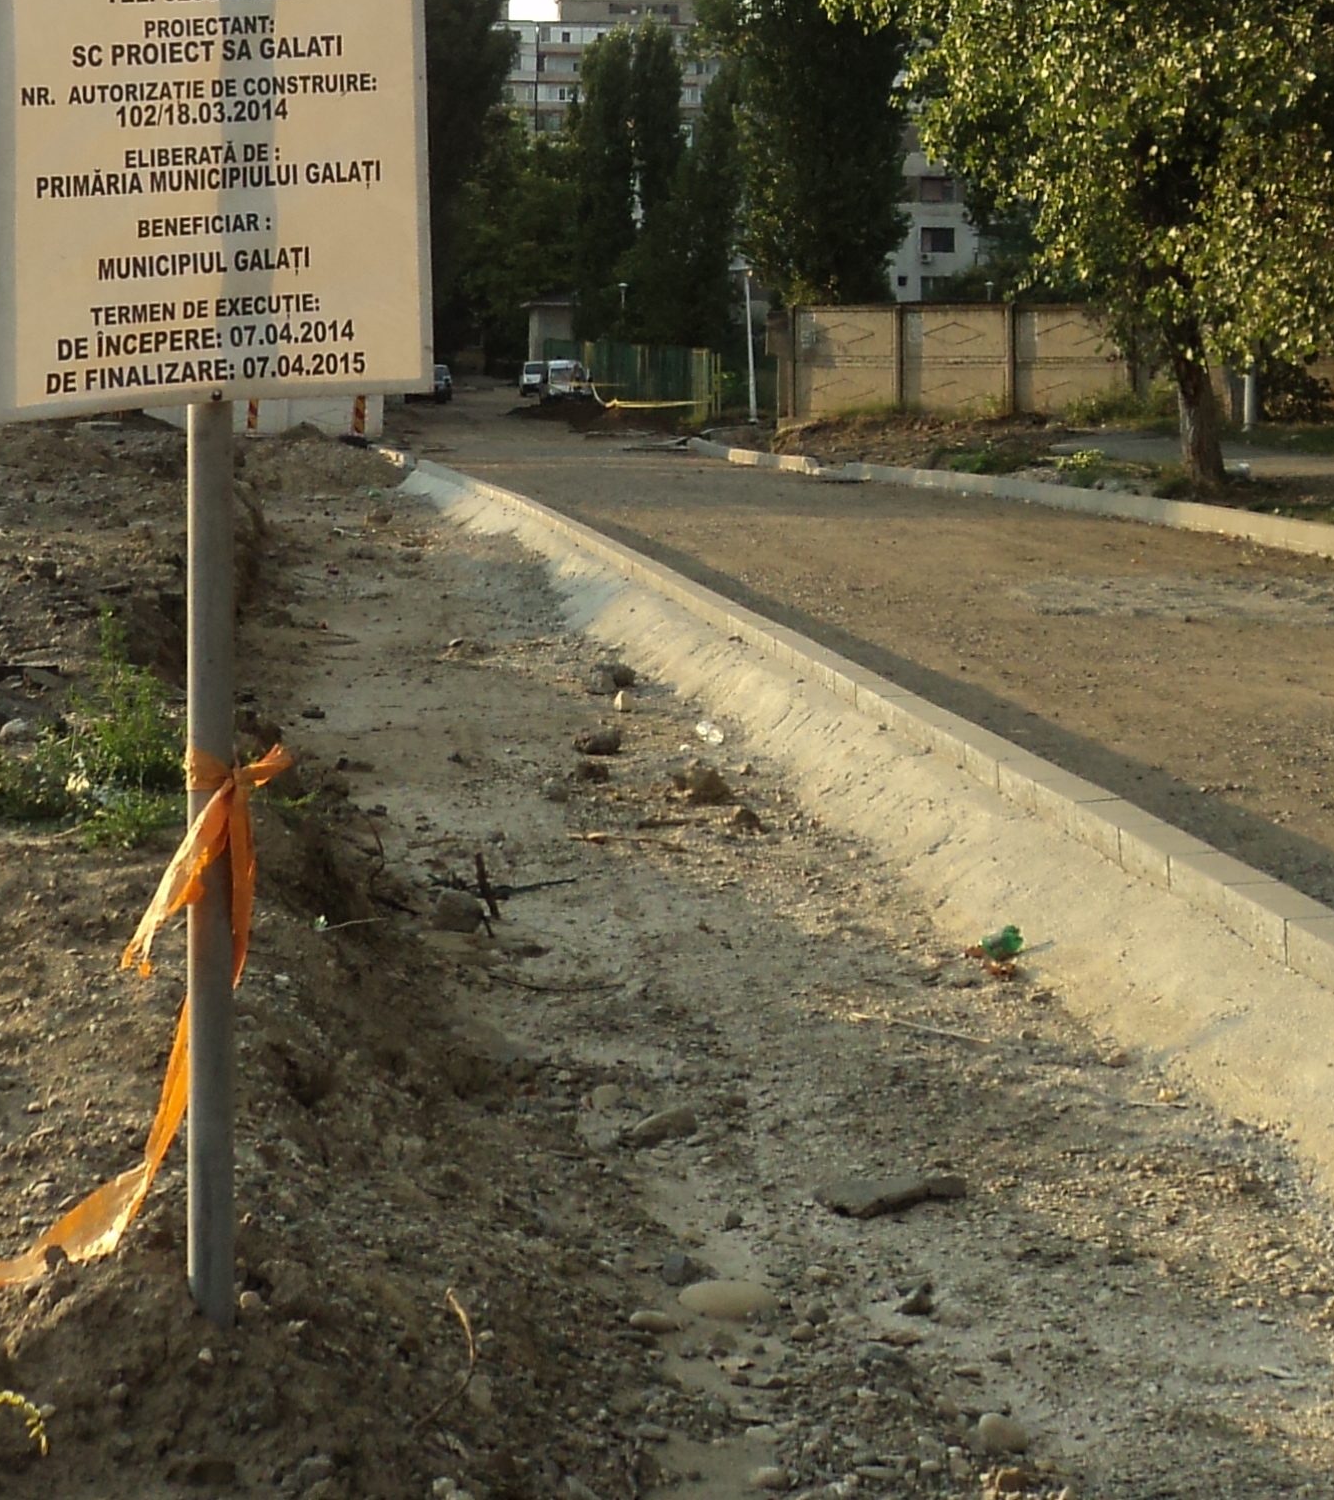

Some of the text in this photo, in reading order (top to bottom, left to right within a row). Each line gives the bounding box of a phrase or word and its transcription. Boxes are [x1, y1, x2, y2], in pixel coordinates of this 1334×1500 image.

[144, 16, 275, 38] PROIECTANT:
[72, 35, 342, 68] SC PROIECT SA GALATI
[21, 87, 55, 106] NR.
[211, 78, 237, 97] DE
[243, 74, 377, 95] CONSTRUIRE:
[115, 99, 288, 128] 102/18.03.2014
[124, 140, 237, 168] ELIBERATĂ
[243, 144, 269, 163] DE
[36, 169, 143, 198] PRIMĂRIA
[150, 164, 298, 191] MUNICIPIULUI
[137, 213, 259, 238] BENEFICIAR
[97, 251, 227, 280] MUNICIPIUL
[90, 303, 176, 325] TERMEN
[182, 301, 208, 319] DE
[57, 319, 354, 361] DE ÎNCEPERE: 07.04.2014
[45, 352, 365, 394] DE FINALIZARE: 07.04.2015
